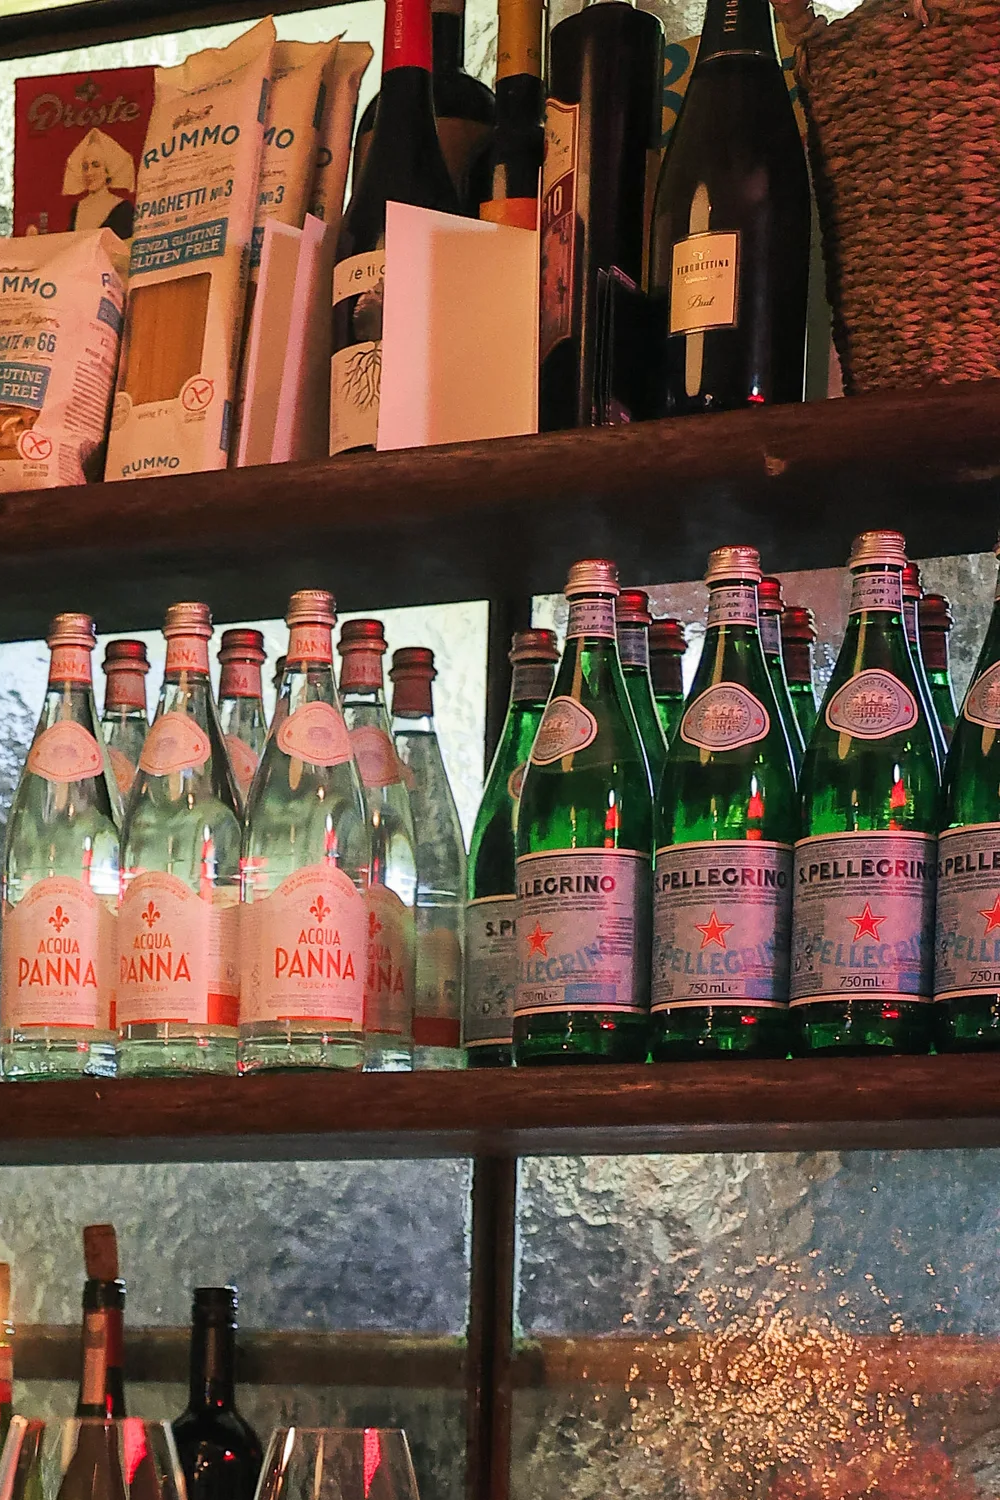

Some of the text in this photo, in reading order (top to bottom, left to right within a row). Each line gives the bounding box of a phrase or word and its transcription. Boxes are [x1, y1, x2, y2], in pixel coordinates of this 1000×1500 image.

[28, 93, 141, 131] Droste
[143, 125, 240, 169] RUMMO
[132, 188, 207, 221] SPAGHETTI
[171, 224, 223, 246] GLUTINE
[131, 238, 221, 268] GLUTEN FREE
[686, 294, 715, 311] Brut
[37, 331, 57, 353] 66
[1, 383, 41, 401] FREE
[121, 456, 180, 477] RUMMO
[37, 937, 80, 955] ACQUA
[133, 932, 172, 950] ACQUA
[298, 927, 341, 947] ACQUA
[18, 956, 98, 988] PANNA
[120, 951, 191, 985] PANNA
[275, 948, 356, 981] PANNA
